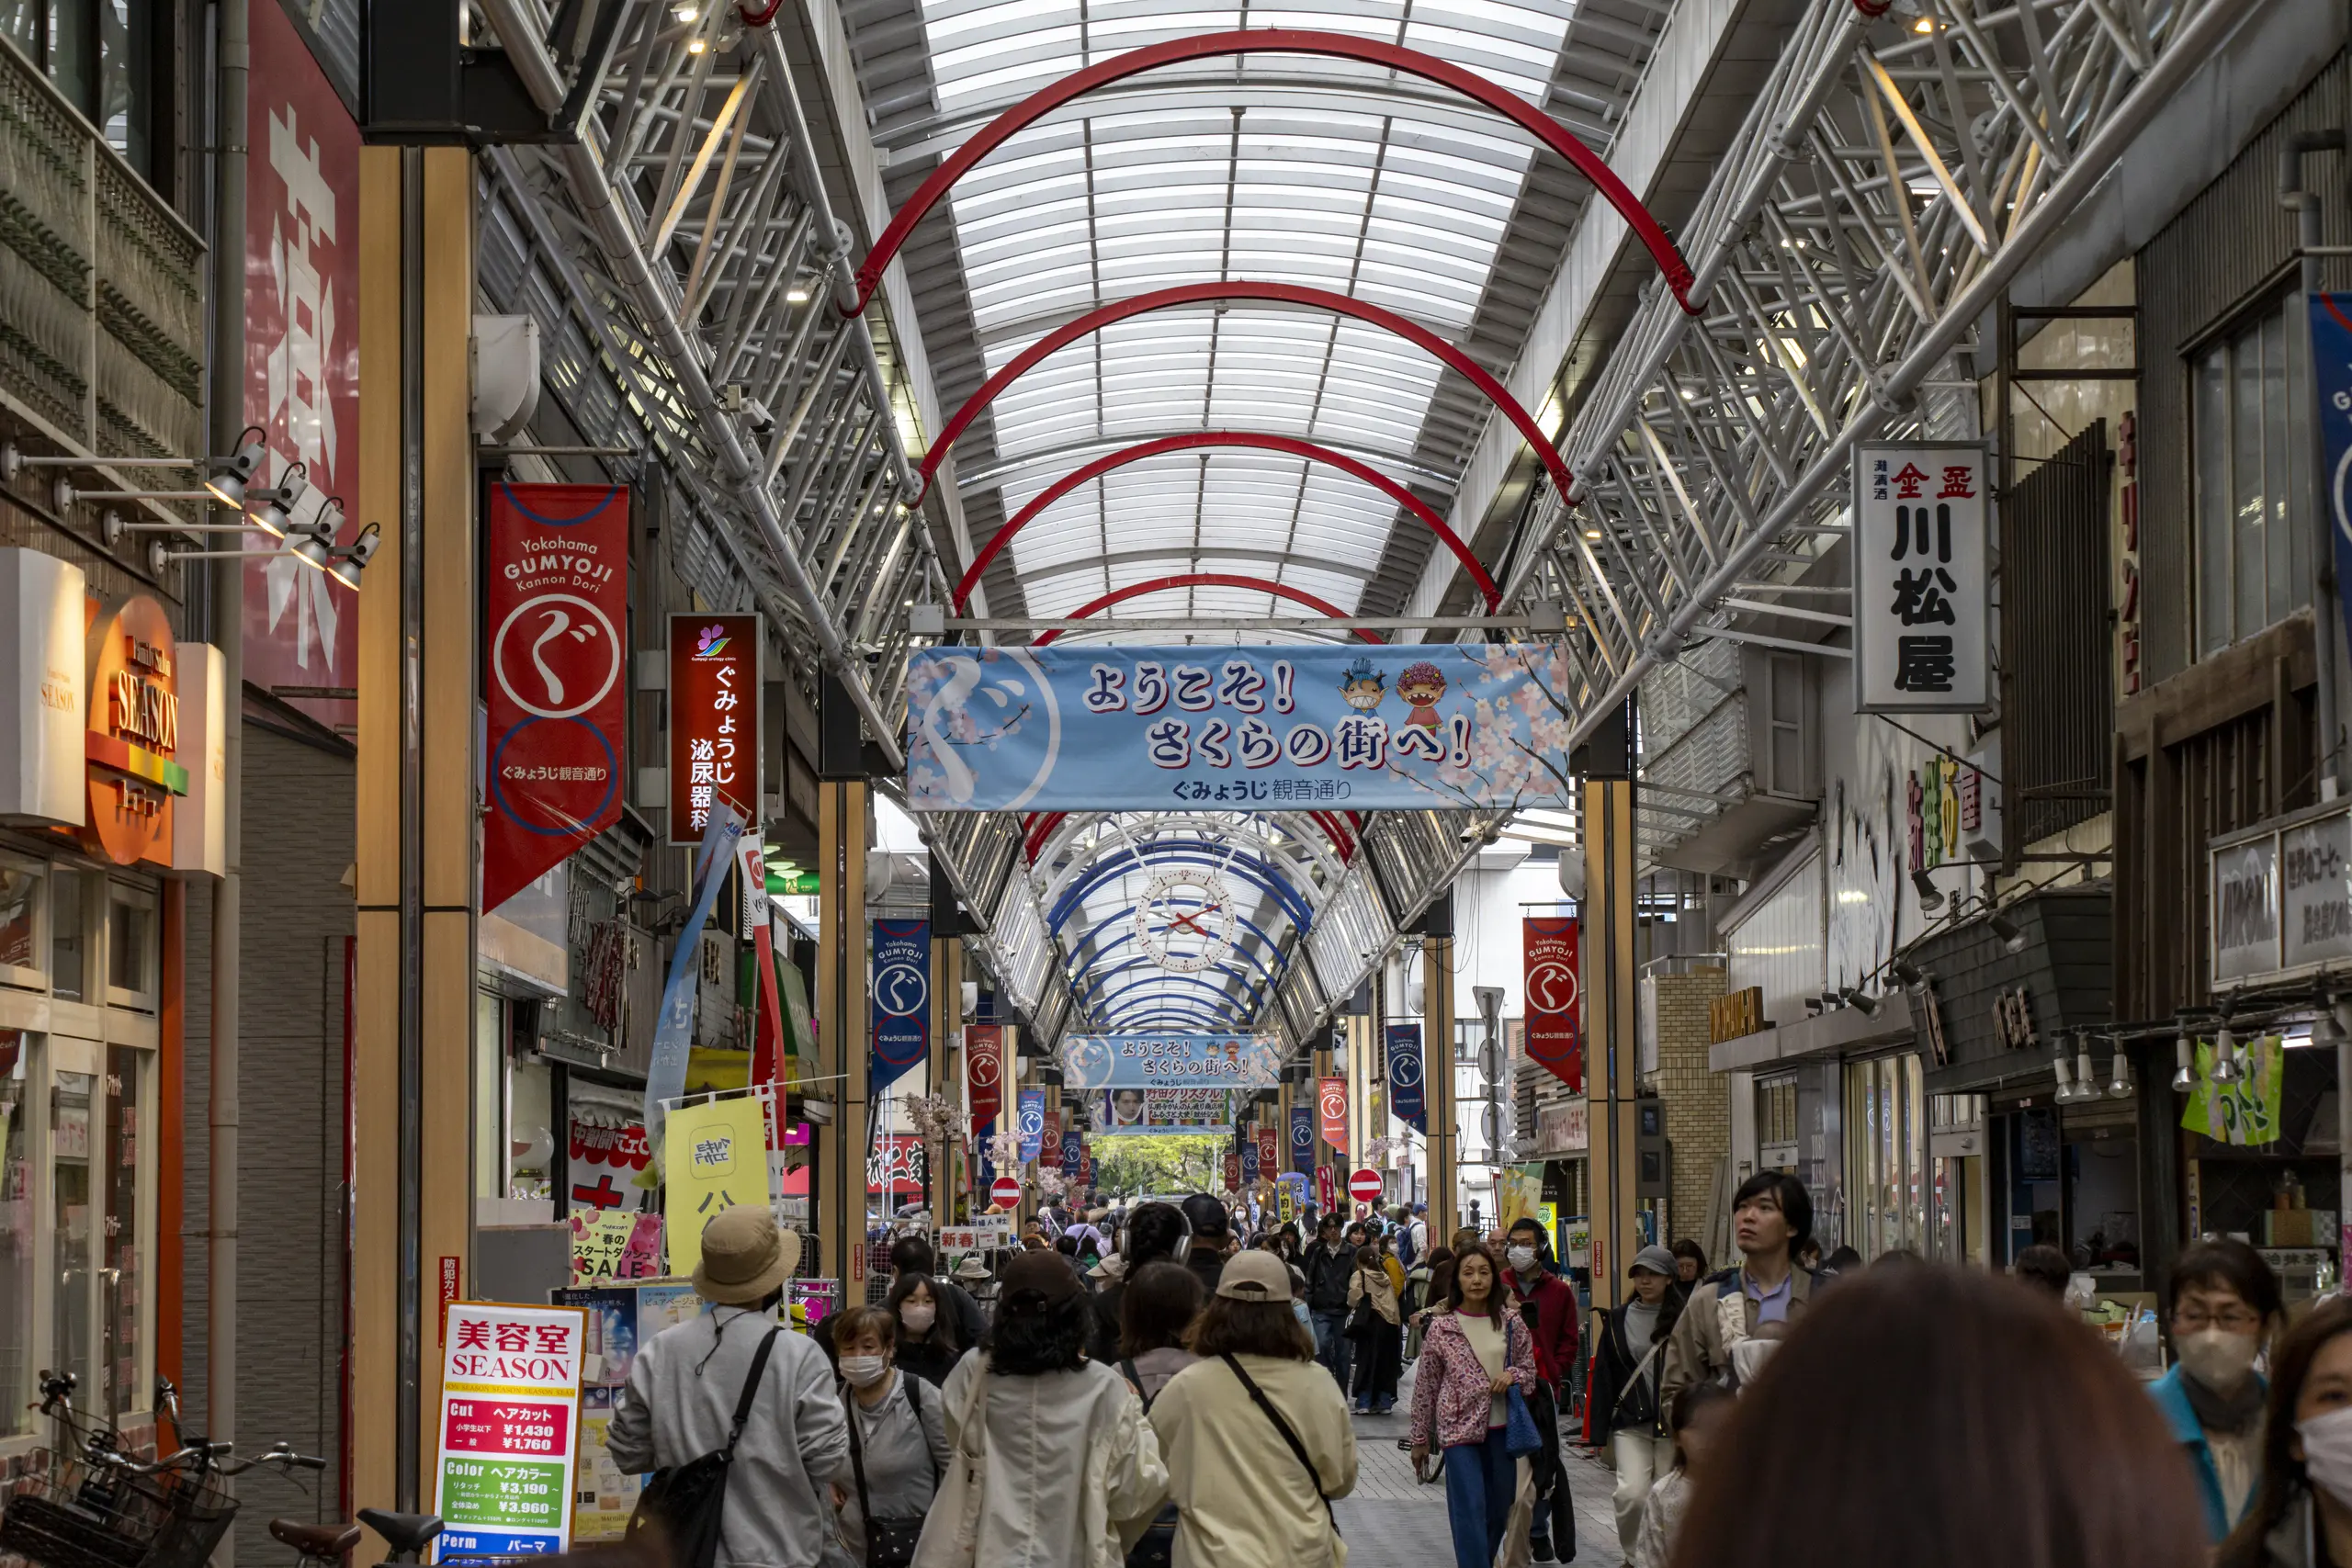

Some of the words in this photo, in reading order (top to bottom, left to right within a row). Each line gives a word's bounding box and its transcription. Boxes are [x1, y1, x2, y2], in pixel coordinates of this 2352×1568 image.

[521, 535, 598, 555] Yokohama
[503, 555, 613, 582] GUMYOJI
[515, 576, 566, 592] Kannon
[572, 575, 601, 593] Dori
[1890, 502, 1957, 694] 川松屋
[1082, 659, 1296, 716] ようこそ！
[118, 669, 180, 752] SEASON
[714, 665, 739, 784] ぐみょうじ
[1146, 715, 1471, 771] さくらの街へ！
[503, 764, 607, 784] ぐみょうじ観音通り
[690, 738, 716, 832] 泌尿器科
[878, 948, 923, 960] GUMYOJI
[885, 940, 917, 948] Yokohama
[1529, 946, 1573, 959] GUMYOJI
[969, 1043, 998, 1051] GUMYOJI
[603, 1234, 626, 1245] 春の
[942, 1232, 974, 1247] 新春
[573, 1245, 652, 1259] スタートダッシュ
[582, 1258, 643, 1279] SALE
[443, 1258, 457, 1303] 防犯カメ
[457, 1319, 571, 1355] 美容室
[451, 1354, 571, 1382] SEASON
[492, 1385, 522, 1394] SEASON
[450, 1403, 473, 1417] Cut
[493, 1407, 552, 1422] ヘアカット
[456, 1424, 492, 1434] 小学生以下
[503, 1424, 554, 1438] ¥1,430
[503, 1438, 551, 1451] ¥1,760
[447, 1461, 484, 1477] Color
[491, 1467, 552, 1481] ヘアカラー
[453, 1482, 481, 1491] リタッチ
[442, 1533, 477, 1550] Perm
[507, 1540, 547, 1553] パーマ
